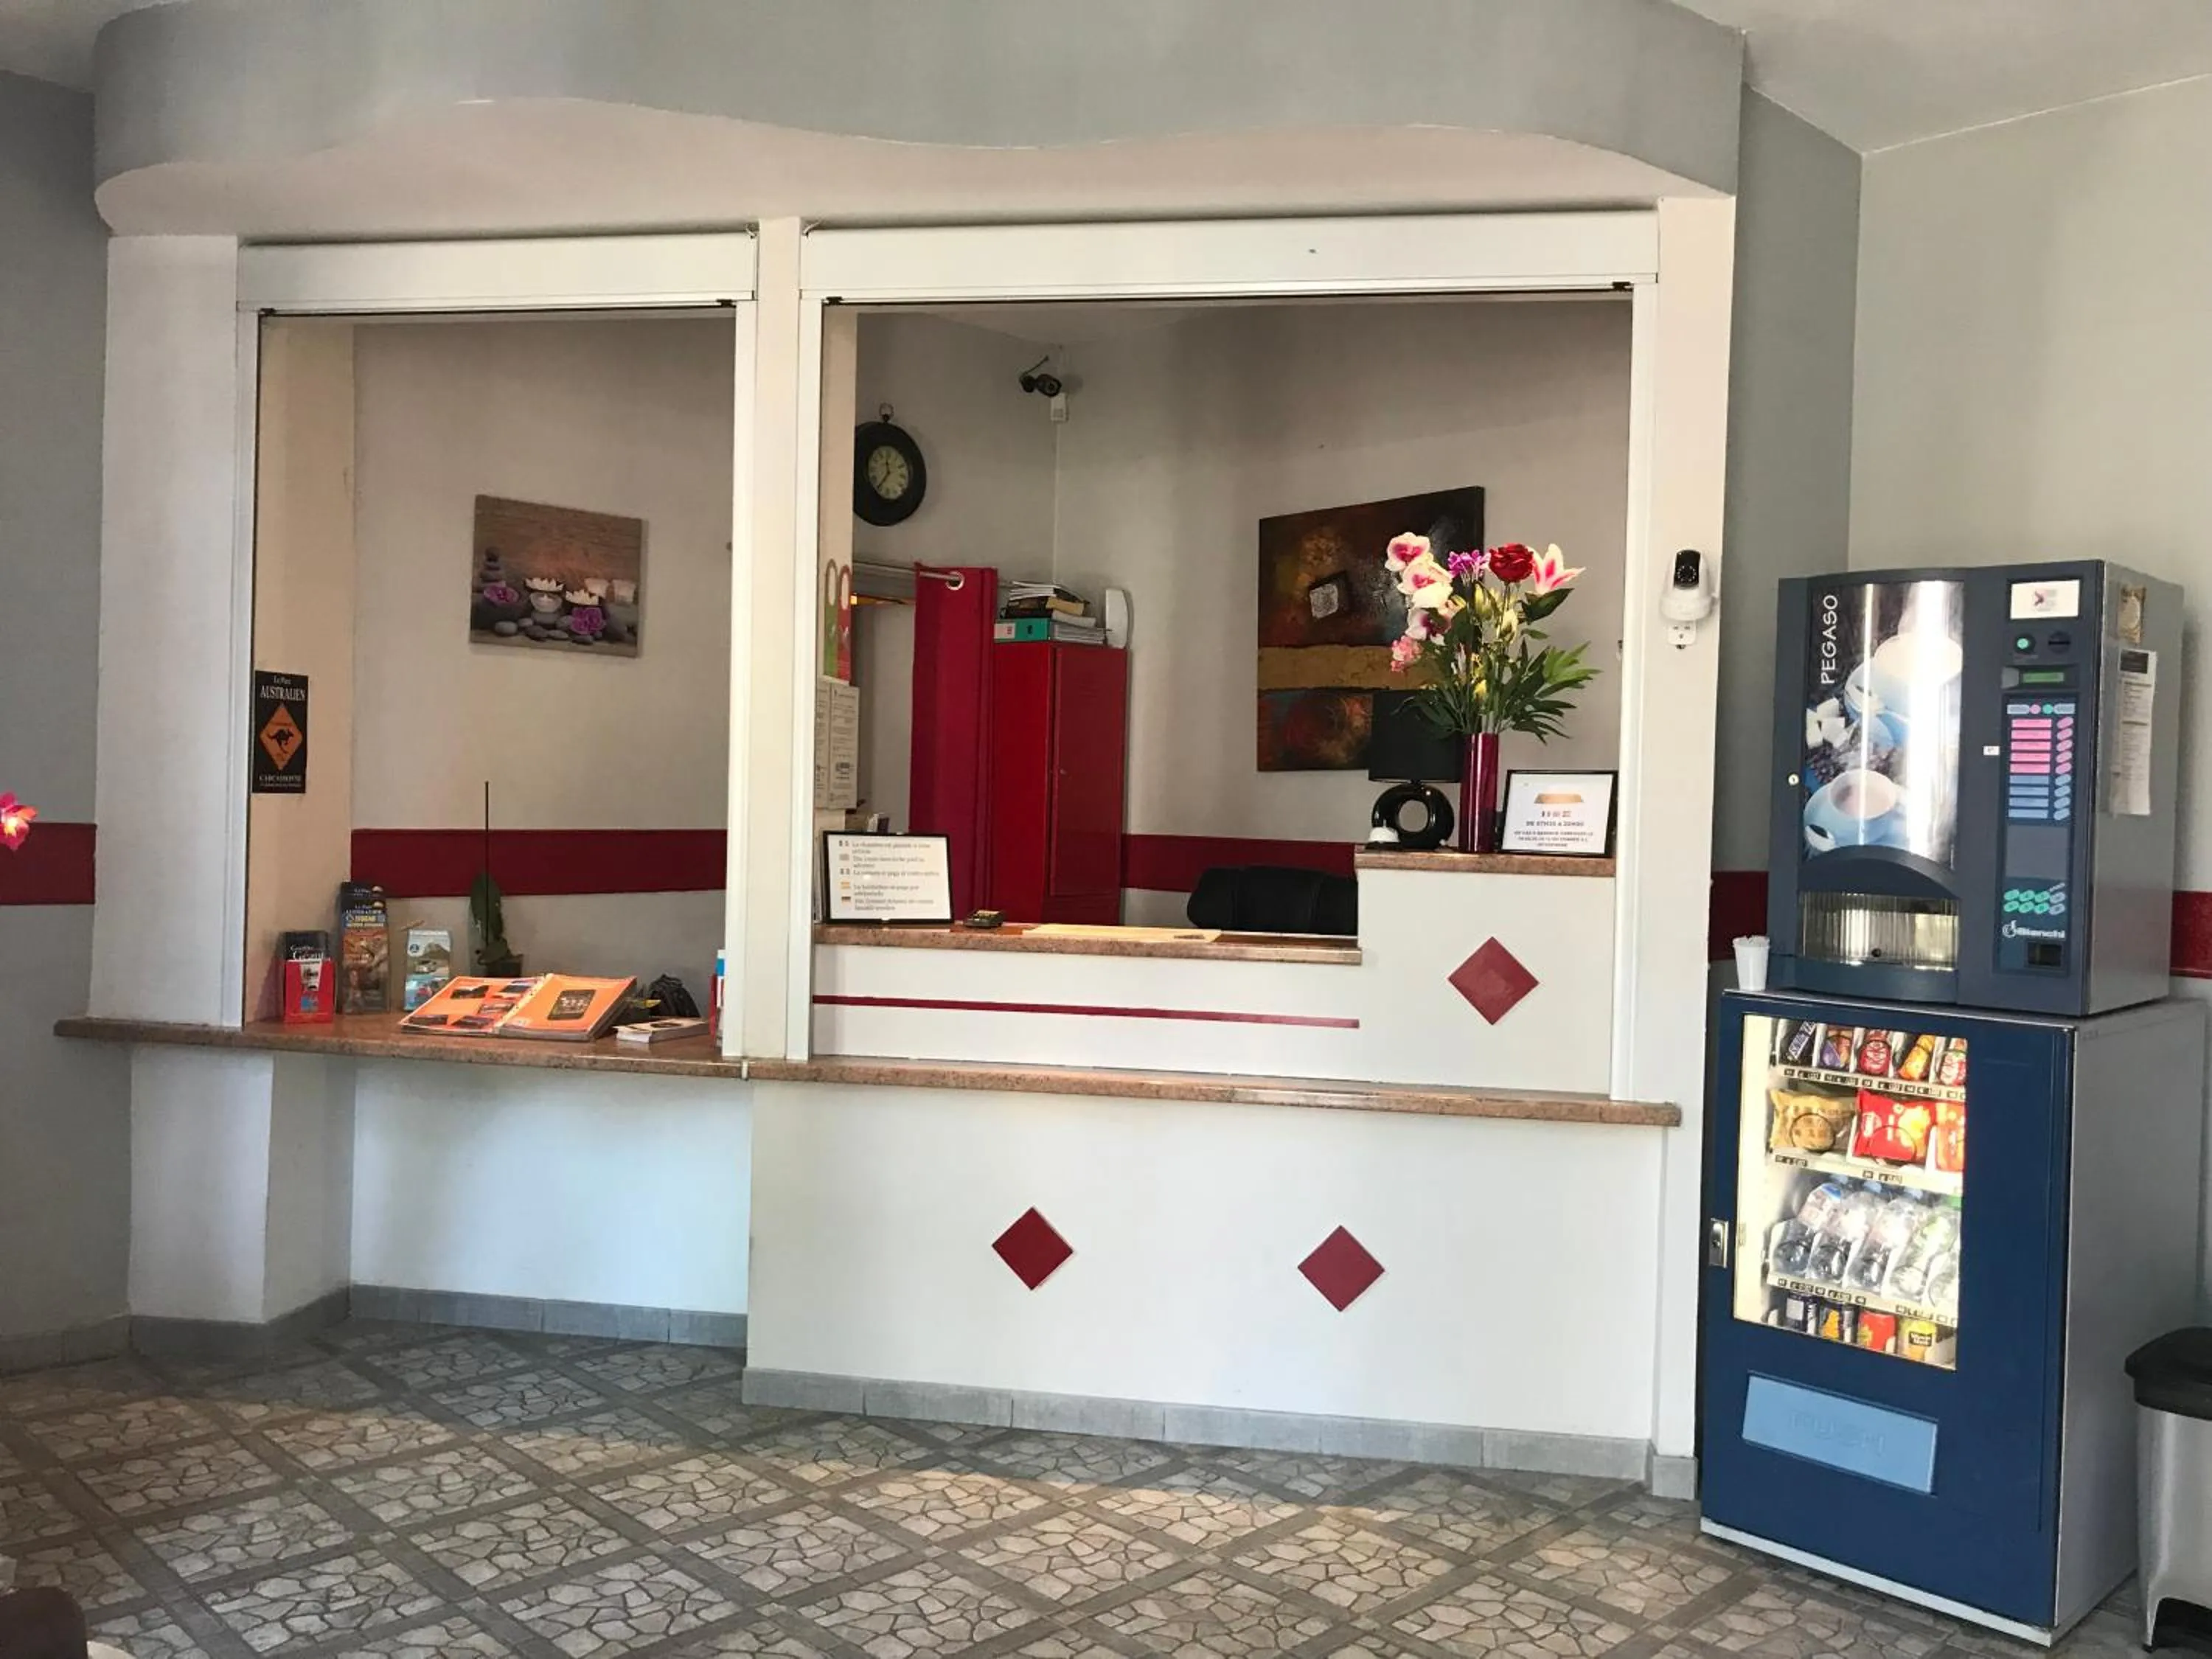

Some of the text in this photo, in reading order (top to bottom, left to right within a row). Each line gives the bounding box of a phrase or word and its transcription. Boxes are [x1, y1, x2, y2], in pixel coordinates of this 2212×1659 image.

[1820, 595, 1838, 684] PEGASO
[260, 685, 306, 701] AUSTRALIEN
[2017, 927, 2065, 938] Bianchi
